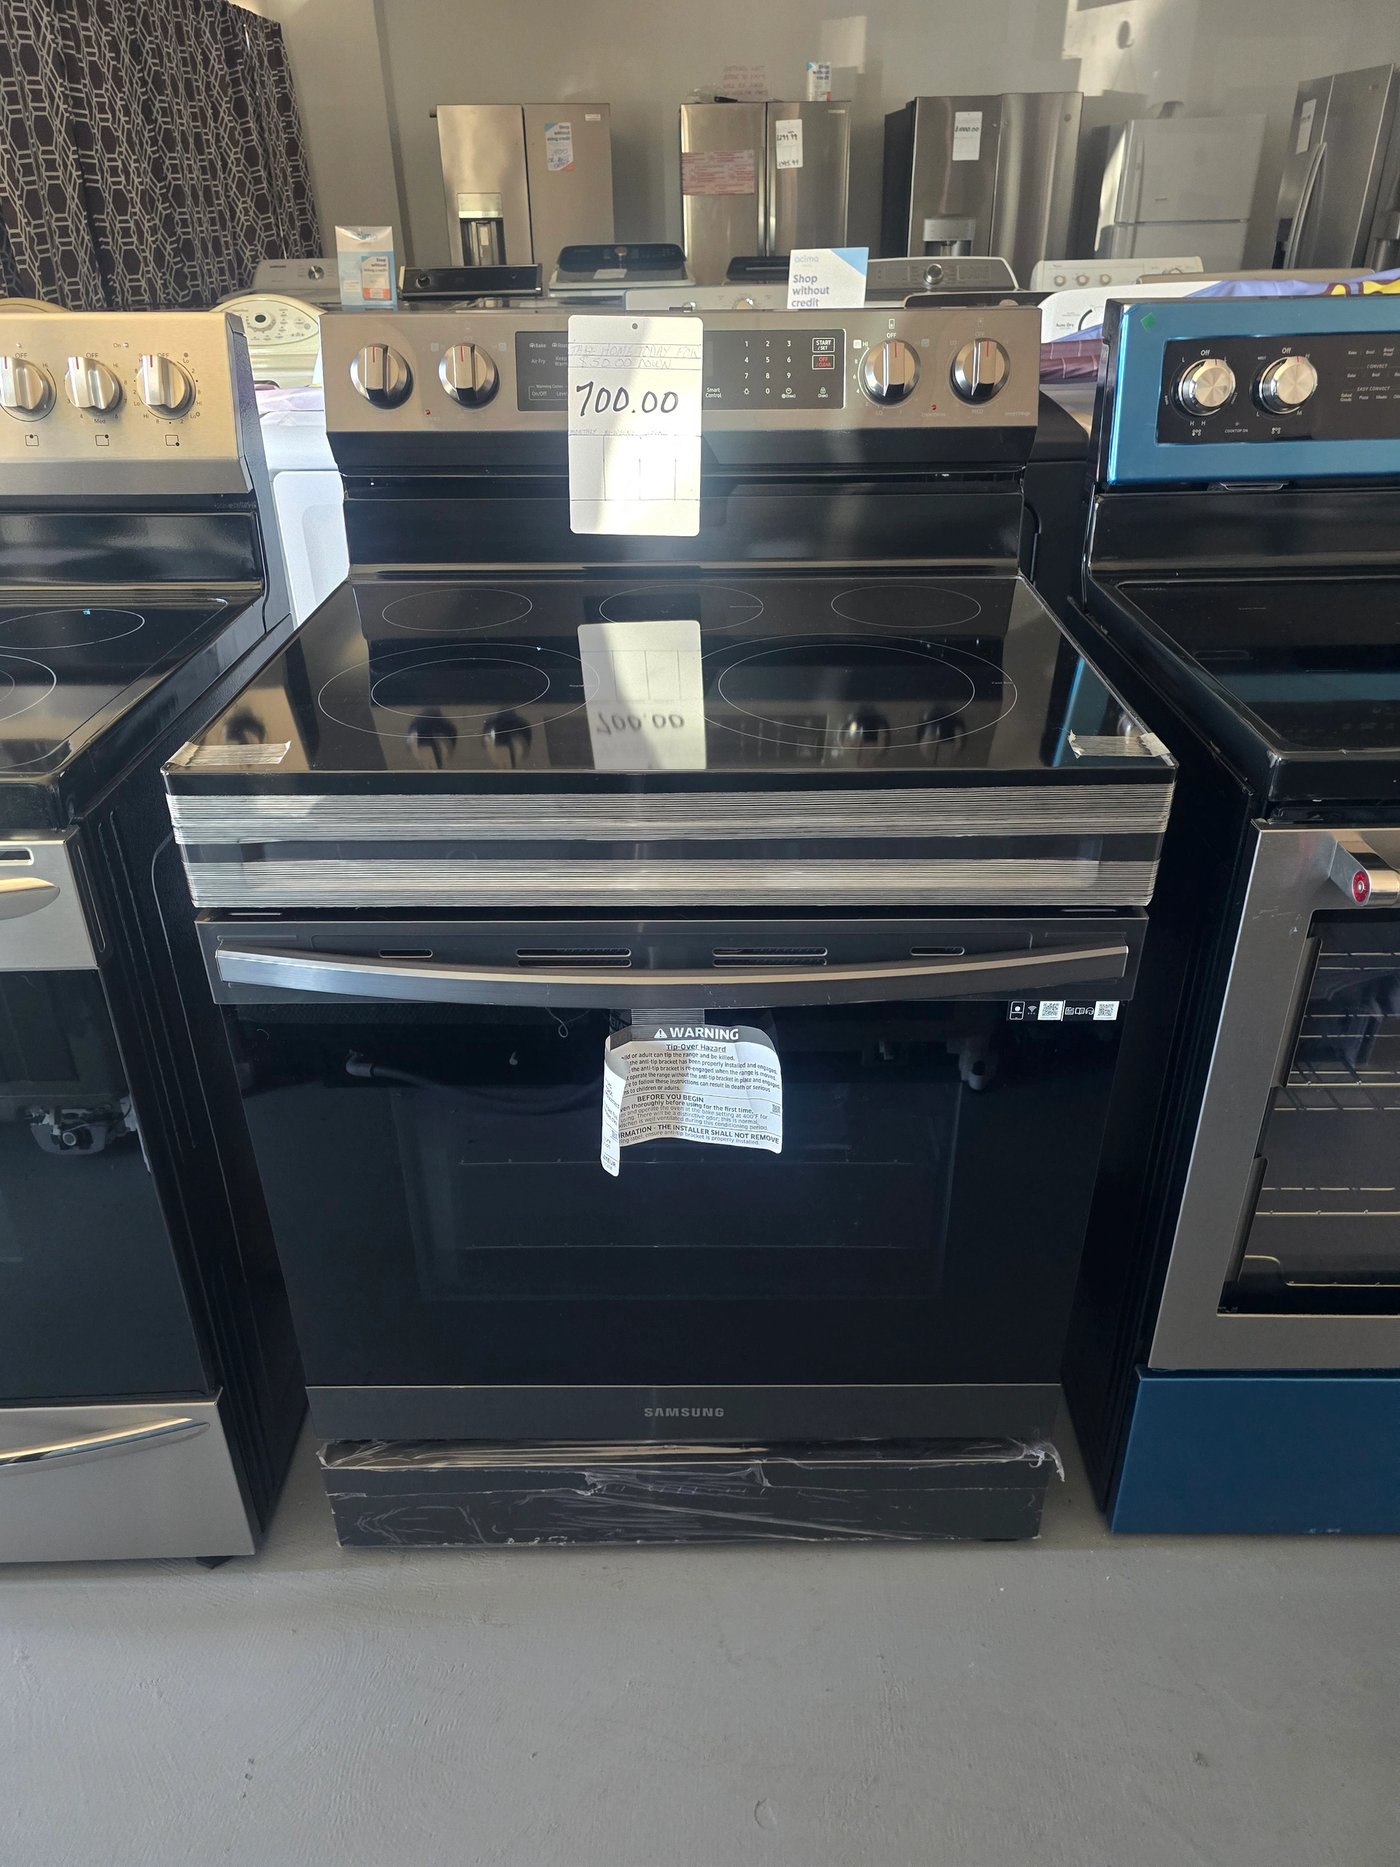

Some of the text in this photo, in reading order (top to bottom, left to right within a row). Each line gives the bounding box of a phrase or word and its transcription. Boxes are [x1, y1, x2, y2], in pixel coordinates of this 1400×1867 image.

[793, 274, 817, 285] Shop
[792, 286, 830, 295] without
[792, 298, 819, 307] credit
[601, 344, 632, 355] HOME
[576, 380, 678, 416] 700.00
[670, 1027, 738, 1040] WARNING
[701, 1044, 726, 1052] Hazard
[637, 1094, 664, 1102] BEFORE
[686, 1101, 702, 1109] using
[638, 1106, 659, 1114] operate
[715, 1121, 748, 1129] conditioning
[672, 1125, 709, 1135] INSTALLER
[751, 1134, 779, 1144] REMOVE
[644, 1408, 724, 1417] SAMSUNG
